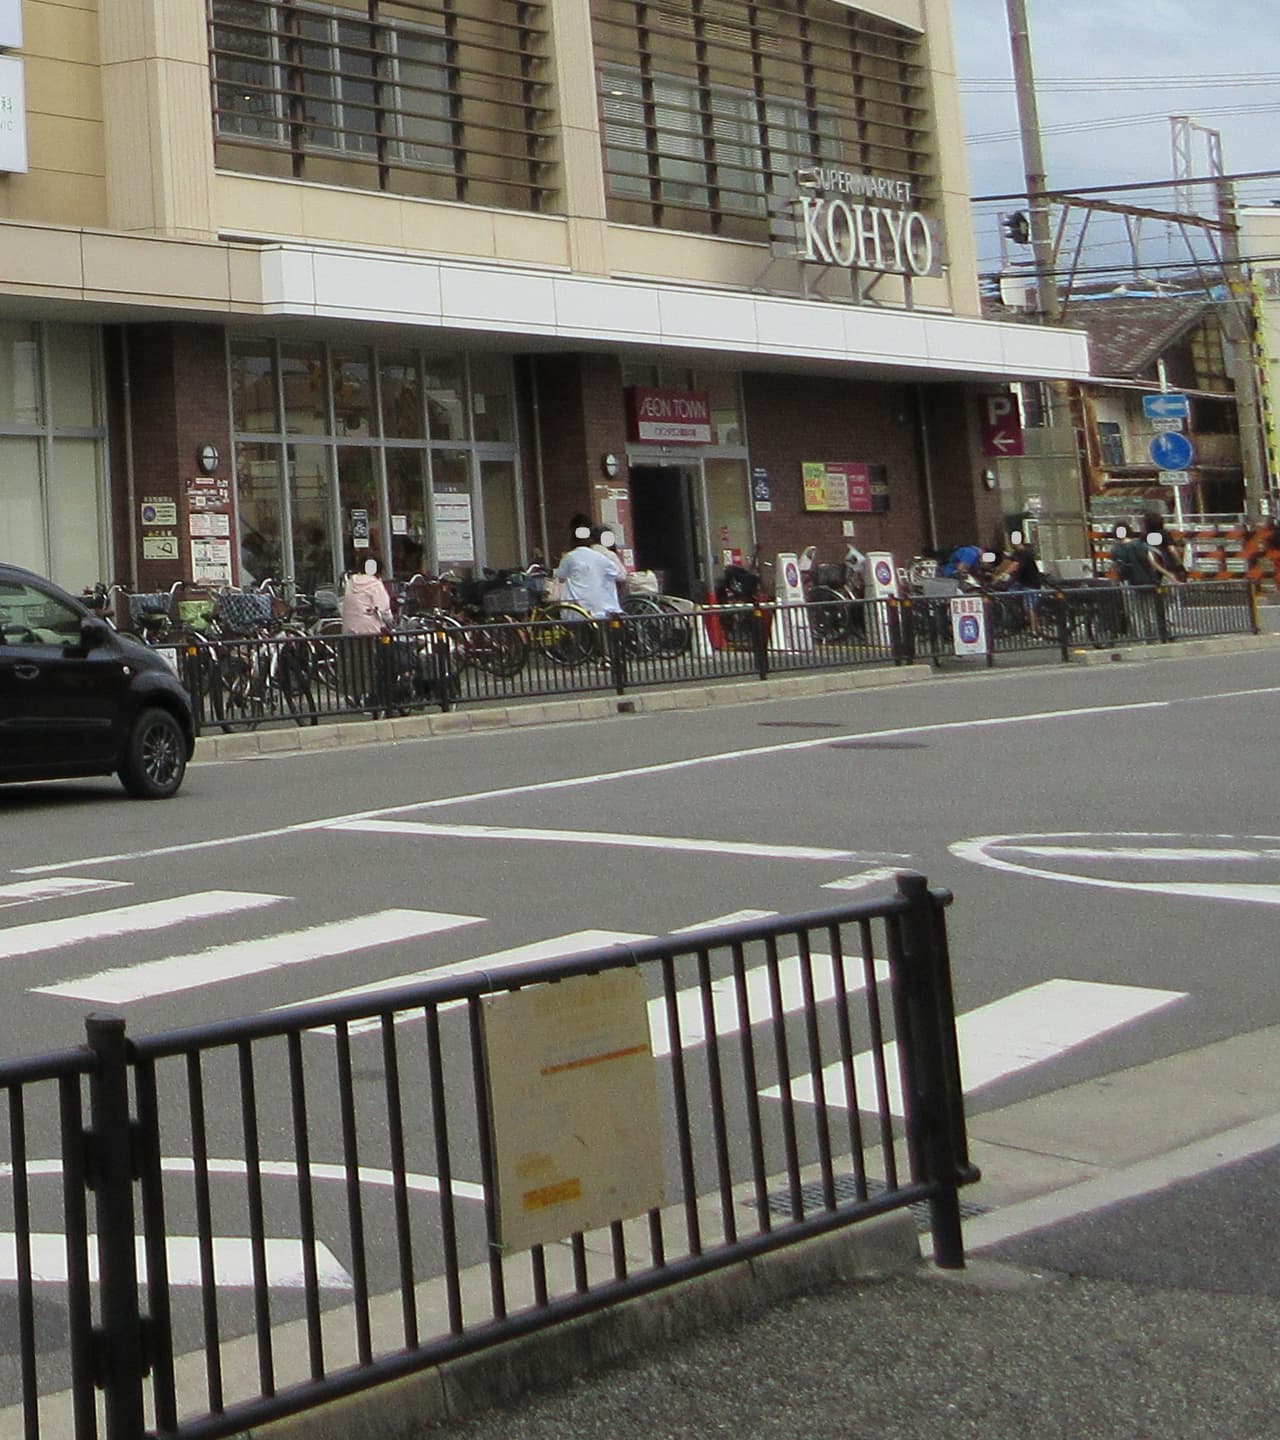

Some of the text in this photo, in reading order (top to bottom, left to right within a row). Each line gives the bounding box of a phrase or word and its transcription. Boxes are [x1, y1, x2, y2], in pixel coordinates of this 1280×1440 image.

[812, 166, 913, 203] SUPERMARKET
[799, 195, 933, 276] KOHYO
[672, 399, 708, 419] TOWN
[988, 397, 1019, 425] P
